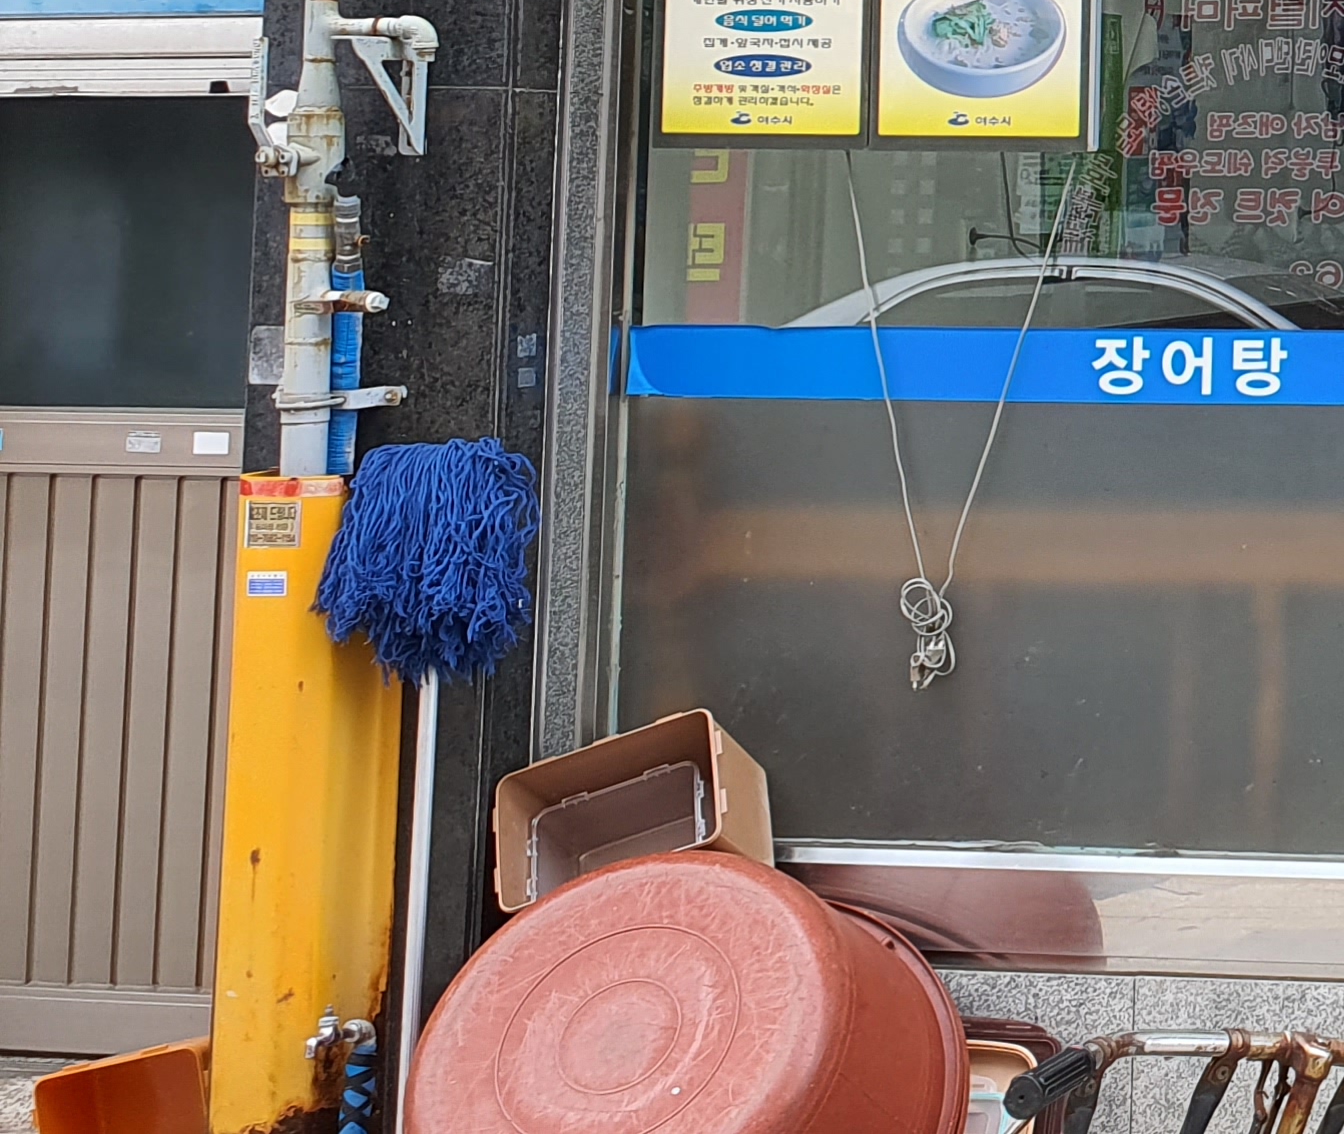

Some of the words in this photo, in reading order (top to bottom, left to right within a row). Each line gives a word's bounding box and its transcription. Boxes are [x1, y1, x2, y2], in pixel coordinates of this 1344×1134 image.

[723, 15, 748, 27] 음식
[751, 15, 777, 27] 덜어
[780, 15, 807, 27] 먹기
[806, 37, 833, 49] 제공
[719, 60, 746, 72] 업소
[779, 60, 807, 72] 관리
[1092, 336, 1288, 396] 장어탕
